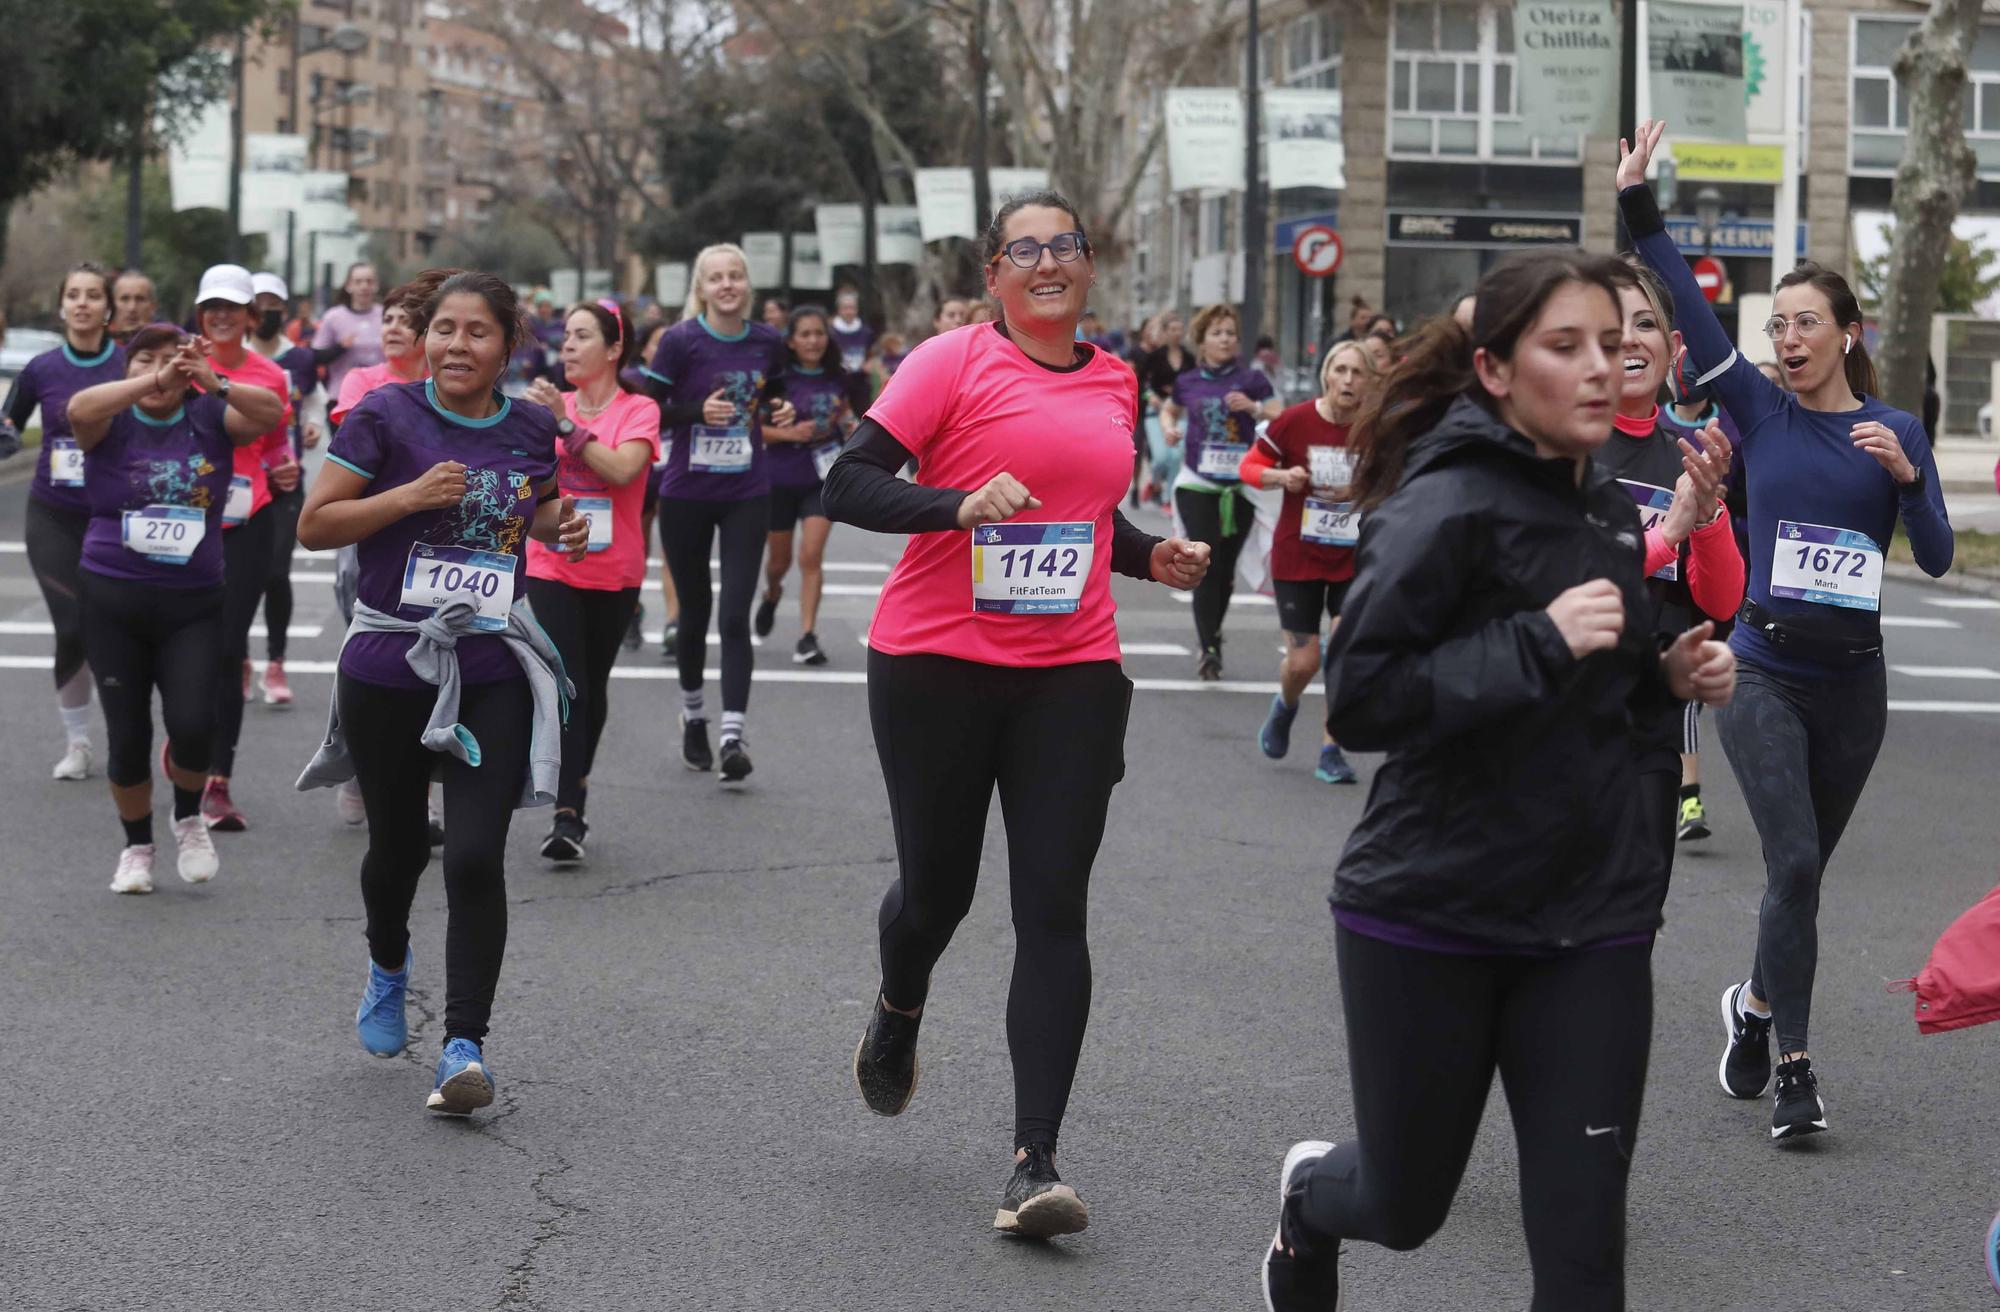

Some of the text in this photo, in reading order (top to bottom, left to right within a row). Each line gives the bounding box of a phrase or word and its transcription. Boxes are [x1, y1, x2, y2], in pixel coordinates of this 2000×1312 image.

[1529, 7, 1601, 26] Oteiza
[1523, 30, 1611, 50] Chillida
[146, 521, 186, 541] 270
[1000, 548, 1079, 578] 1142
[1797, 546, 1867, 578] 1672
[429, 564, 499, 598] 1040
[1010, 586, 1066, 596] FitFatTeam
[1814, 578, 1838, 590] Marta
